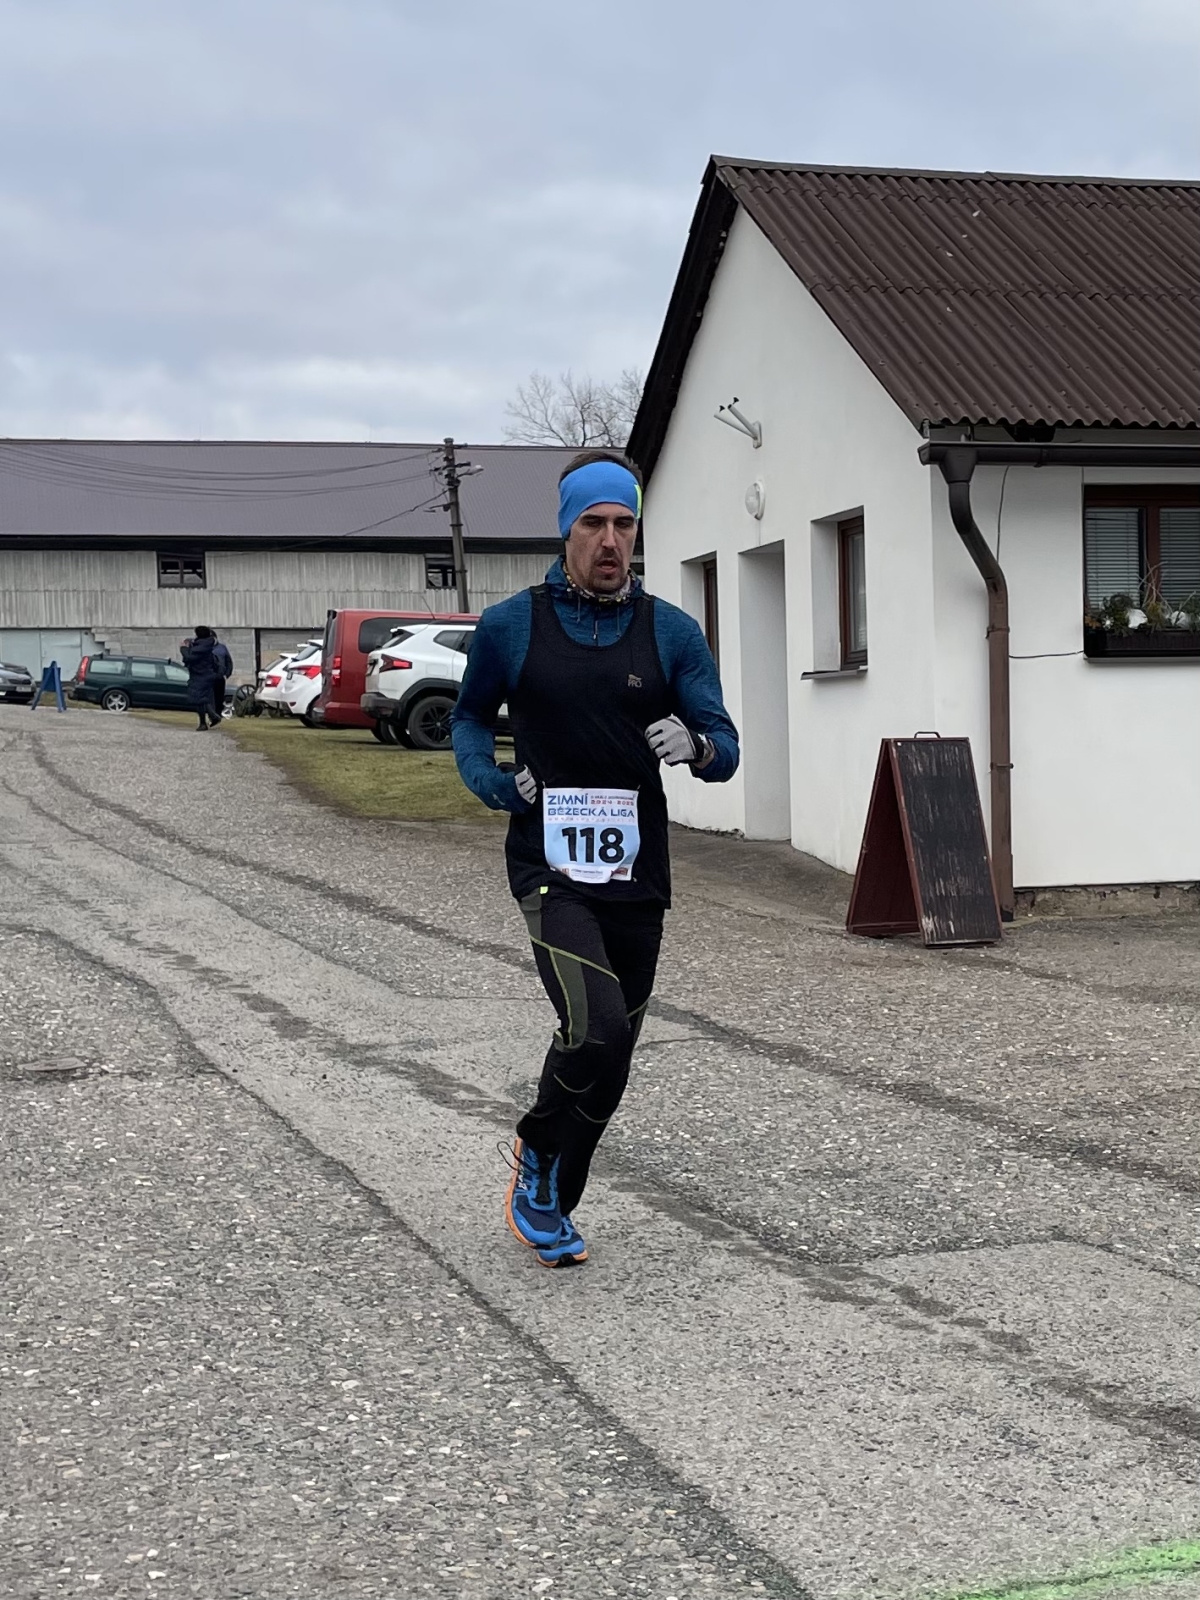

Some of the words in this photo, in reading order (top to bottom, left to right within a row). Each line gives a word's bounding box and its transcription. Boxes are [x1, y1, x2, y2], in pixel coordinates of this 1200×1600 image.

[547, 793, 589, 806] ZIMNÍ
[547, 806, 607, 817] BĚŽECKÁ
[610, 808, 635, 818] LIGA
[561, 826, 625, 864] 118
